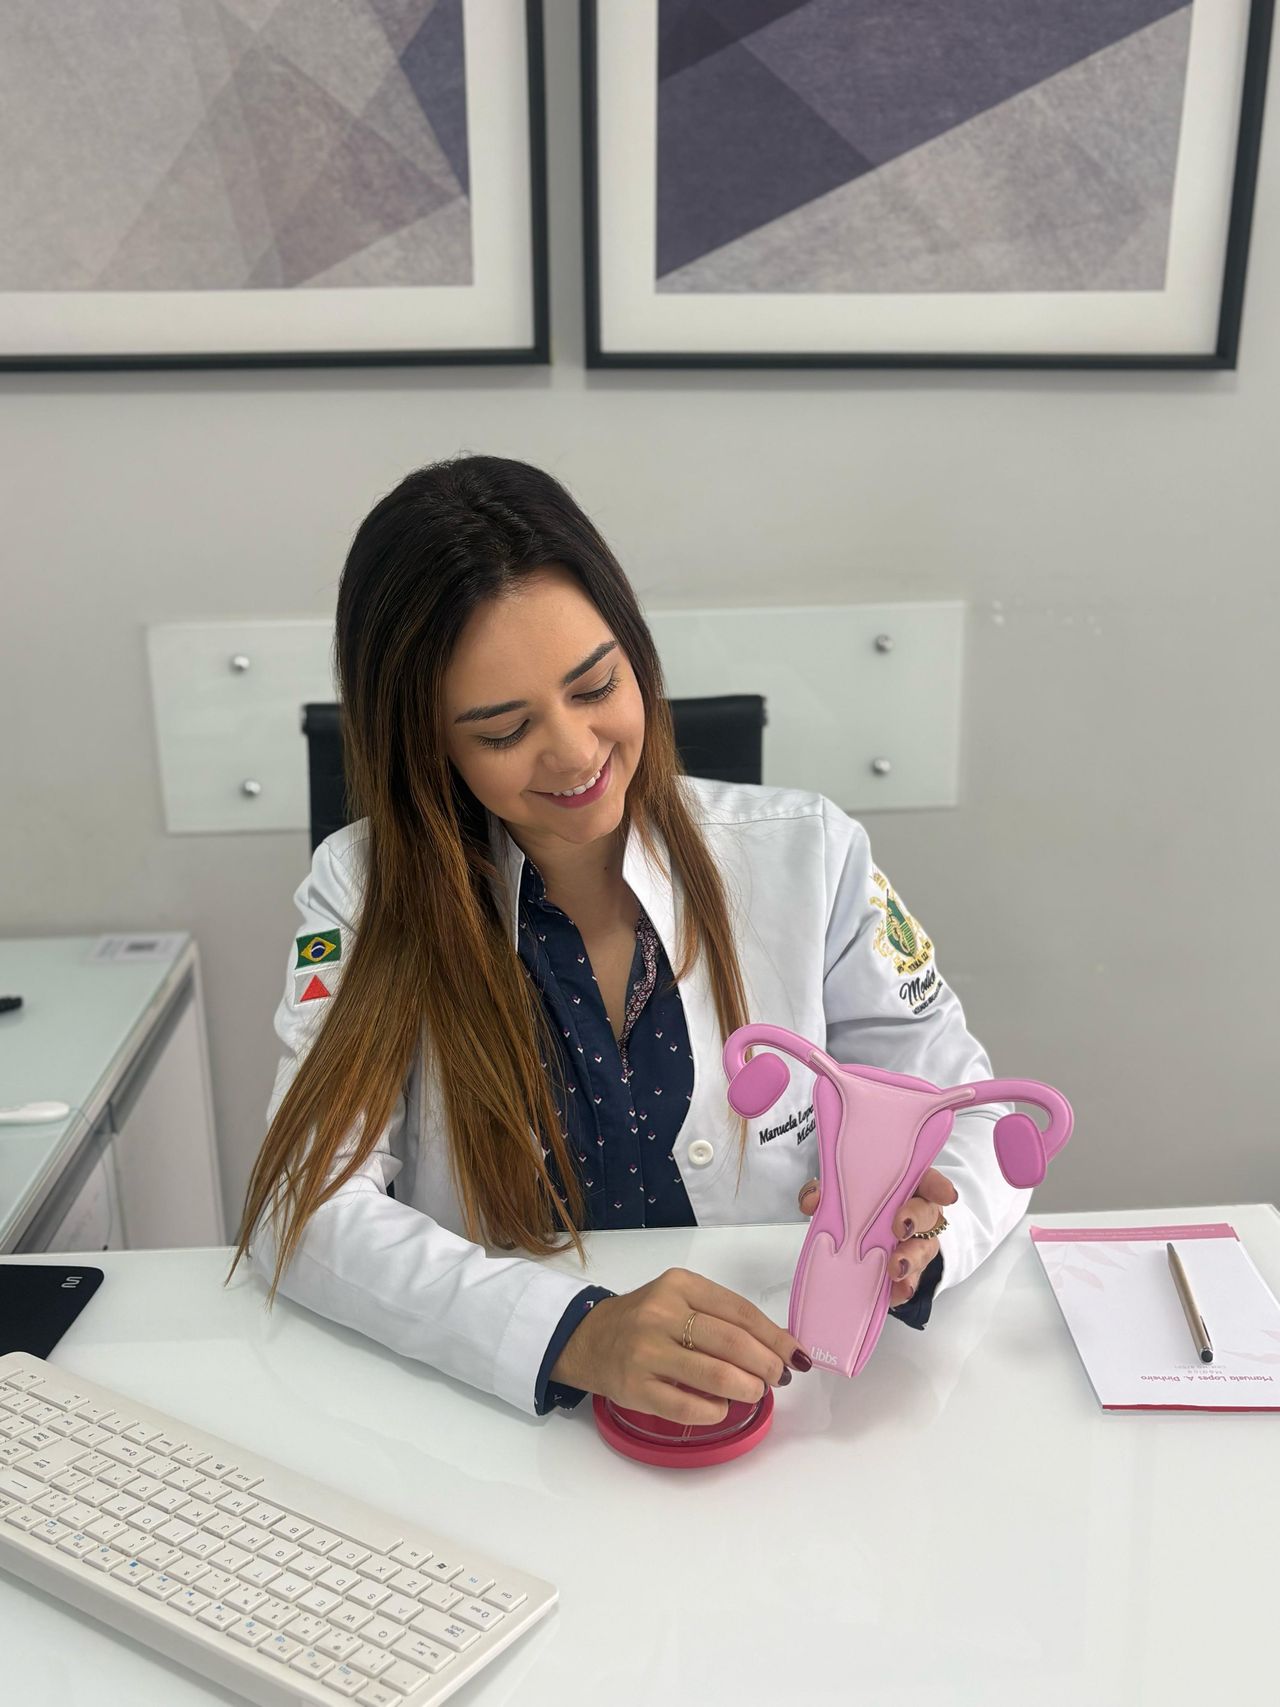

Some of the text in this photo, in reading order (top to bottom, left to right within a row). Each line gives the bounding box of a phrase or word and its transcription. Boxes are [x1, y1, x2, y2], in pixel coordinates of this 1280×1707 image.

[759, 1114, 798, 1145] Manuela
[811, 1346, 837, 1365] Libbs
[196, 1543, 207, 1551] U
[407, 1580, 417, 1588] Z
[342, 1614, 355, 1623] W
[378, 1630, 388, 1638] Q
